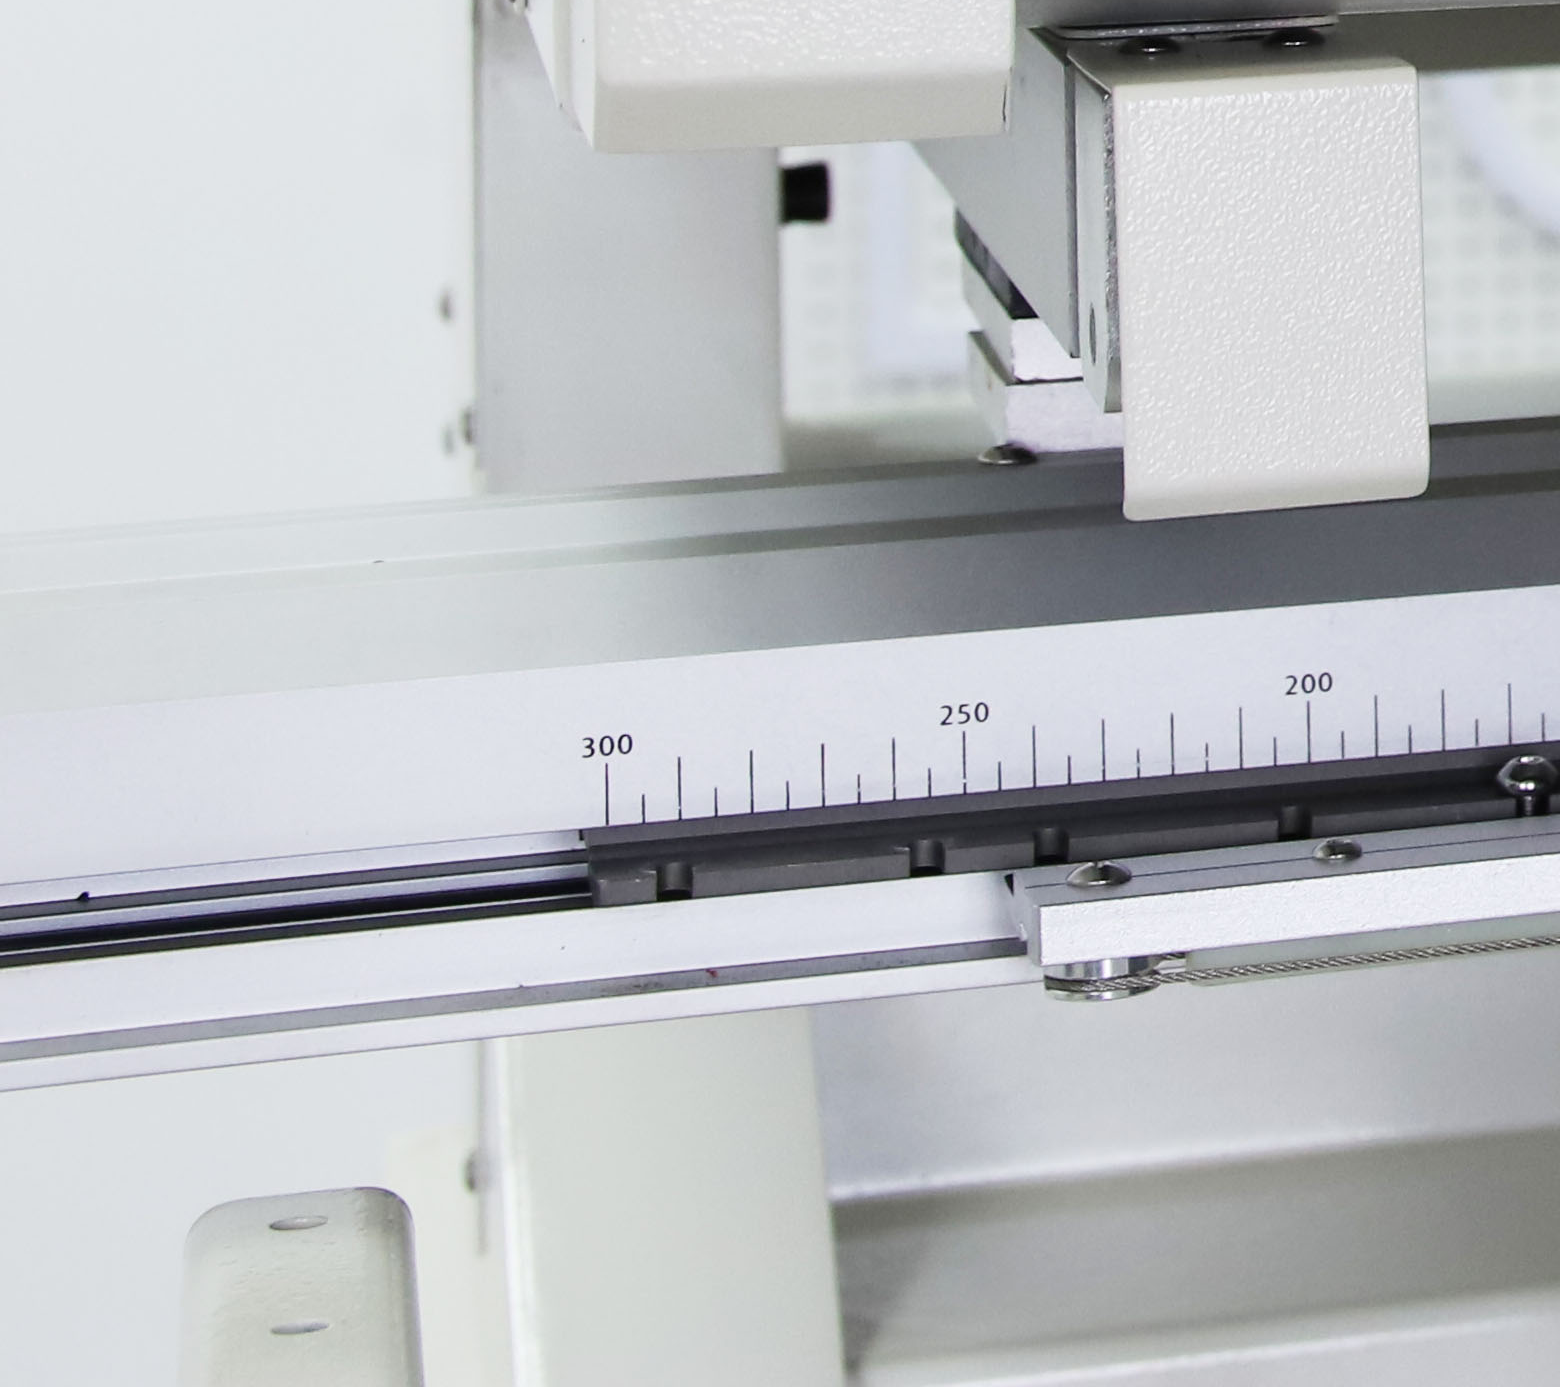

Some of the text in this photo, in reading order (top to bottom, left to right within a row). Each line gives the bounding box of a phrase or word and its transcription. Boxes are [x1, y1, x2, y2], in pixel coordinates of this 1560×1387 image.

[581, 733, 634, 758] 300
[939, 701, 990, 726] 250
[1284, 671, 1334, 696] 200
